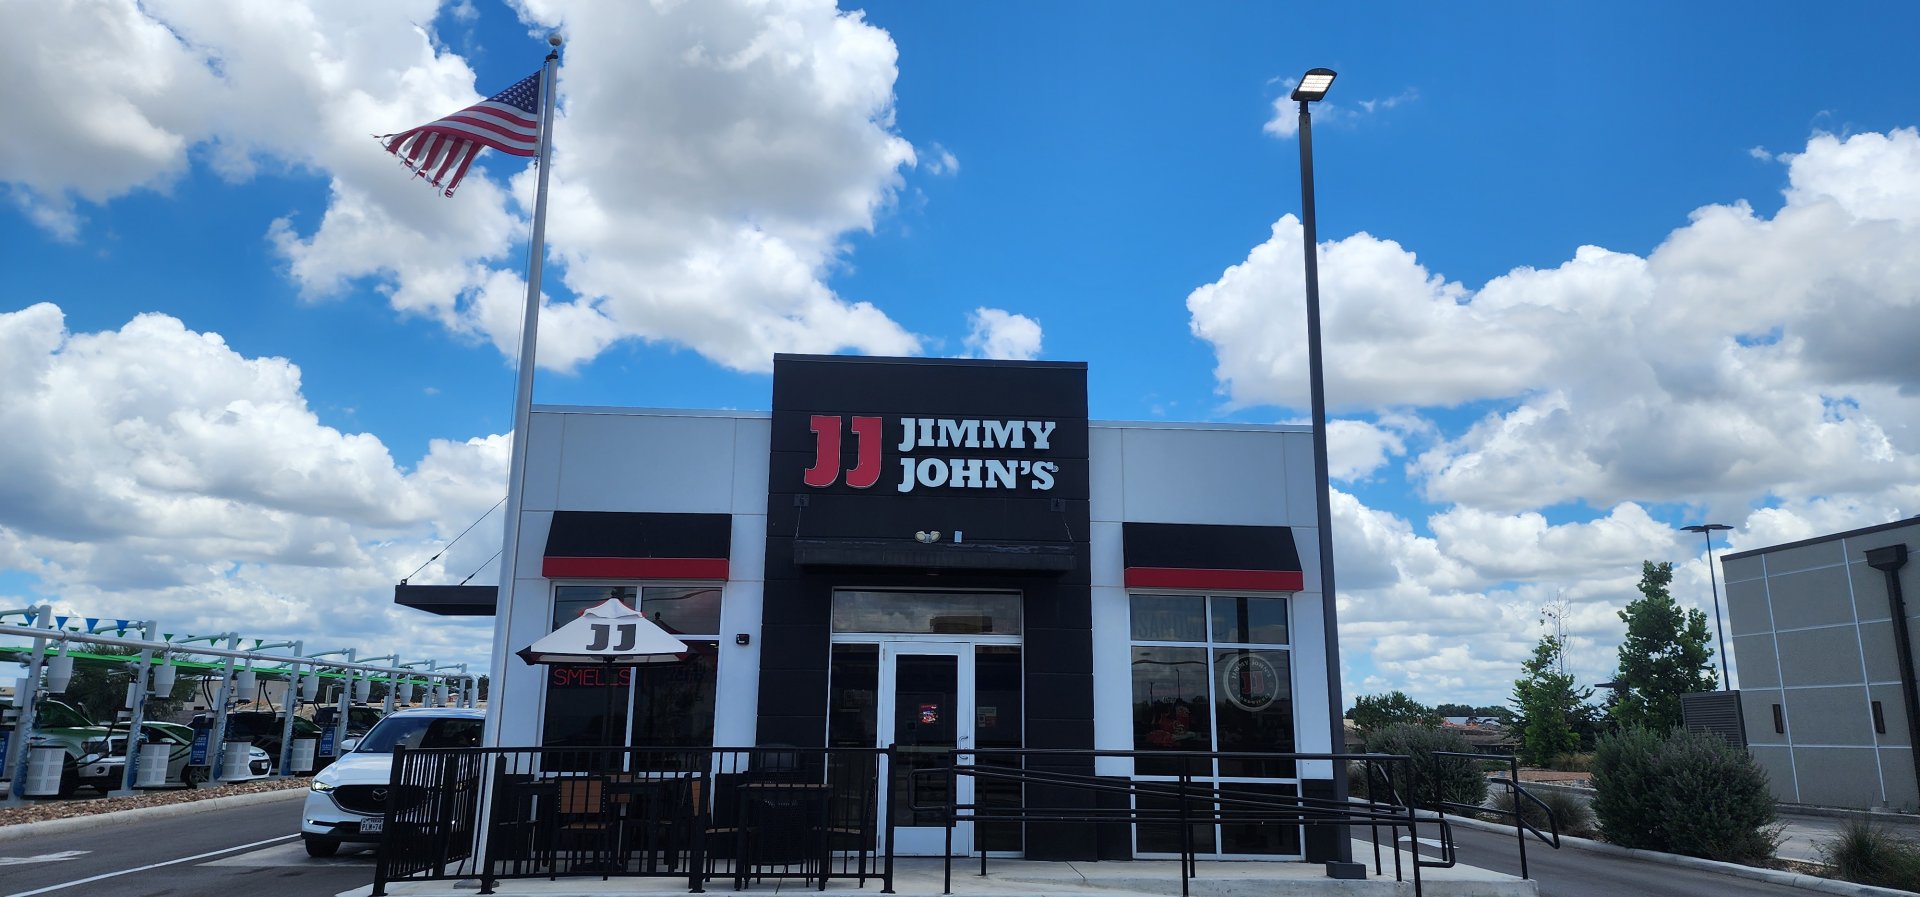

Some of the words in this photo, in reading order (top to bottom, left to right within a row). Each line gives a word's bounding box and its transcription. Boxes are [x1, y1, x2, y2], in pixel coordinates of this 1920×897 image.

[804, 415, 882, 488] JJ
[898, 418, 1056, 452] JIMMY
[898, 458, 1057, 492] JOHN'S
[586, 624, 636, 651] JJ
[554, 668, 631, 686] SMELS
